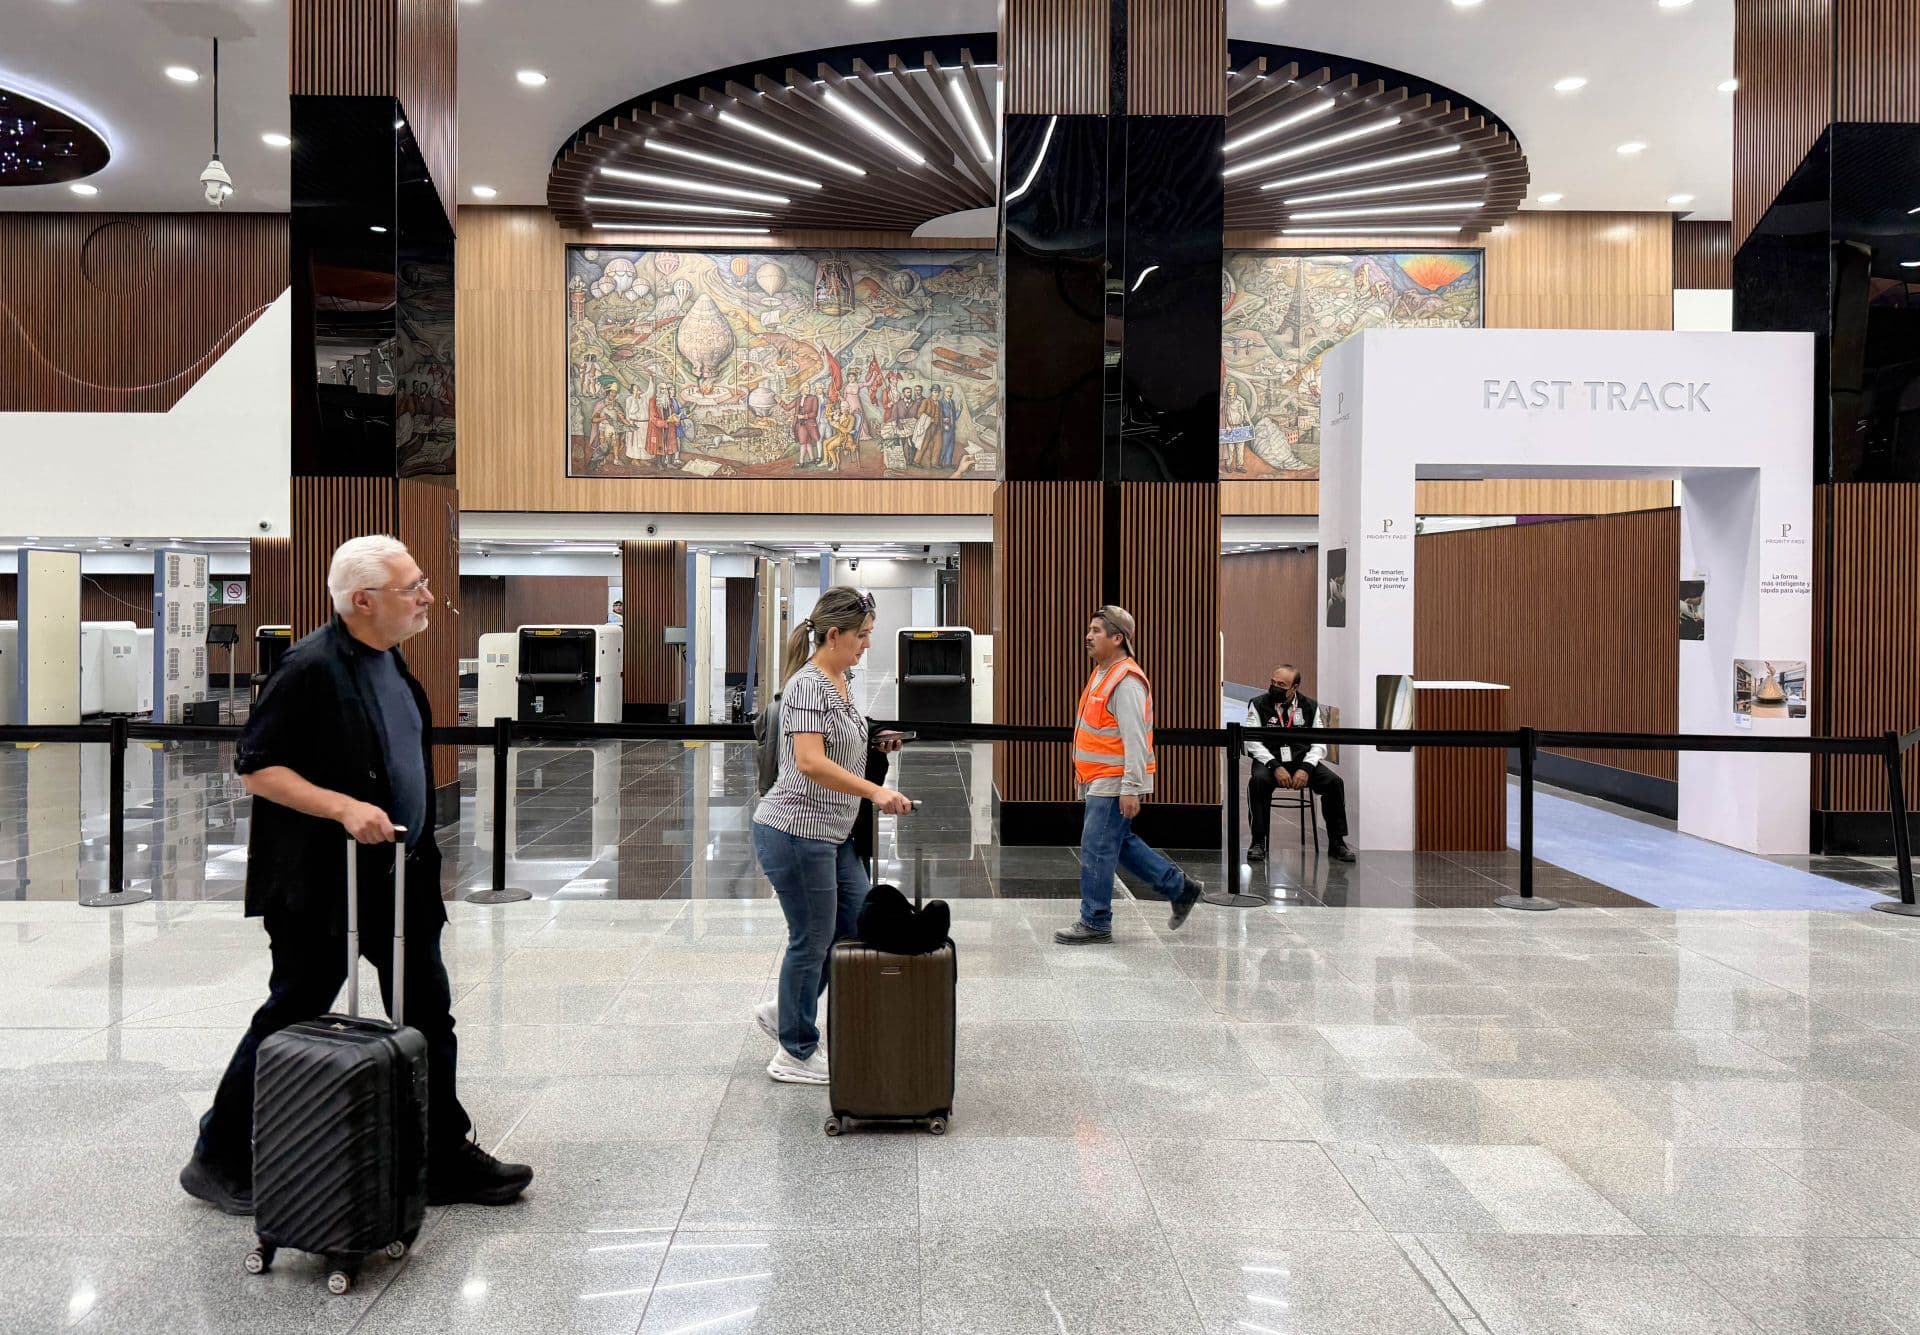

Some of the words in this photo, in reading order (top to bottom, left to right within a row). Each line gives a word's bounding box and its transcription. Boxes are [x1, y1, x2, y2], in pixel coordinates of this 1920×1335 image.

[1483, 379, 1572, 410] FAST
[1583, 381, 1711, 412] TRACK
[1383, 519, 1394, 533] P
[1383, 582, 1406, 590] journey
[1774, 580, 1806, 588] inteligente
